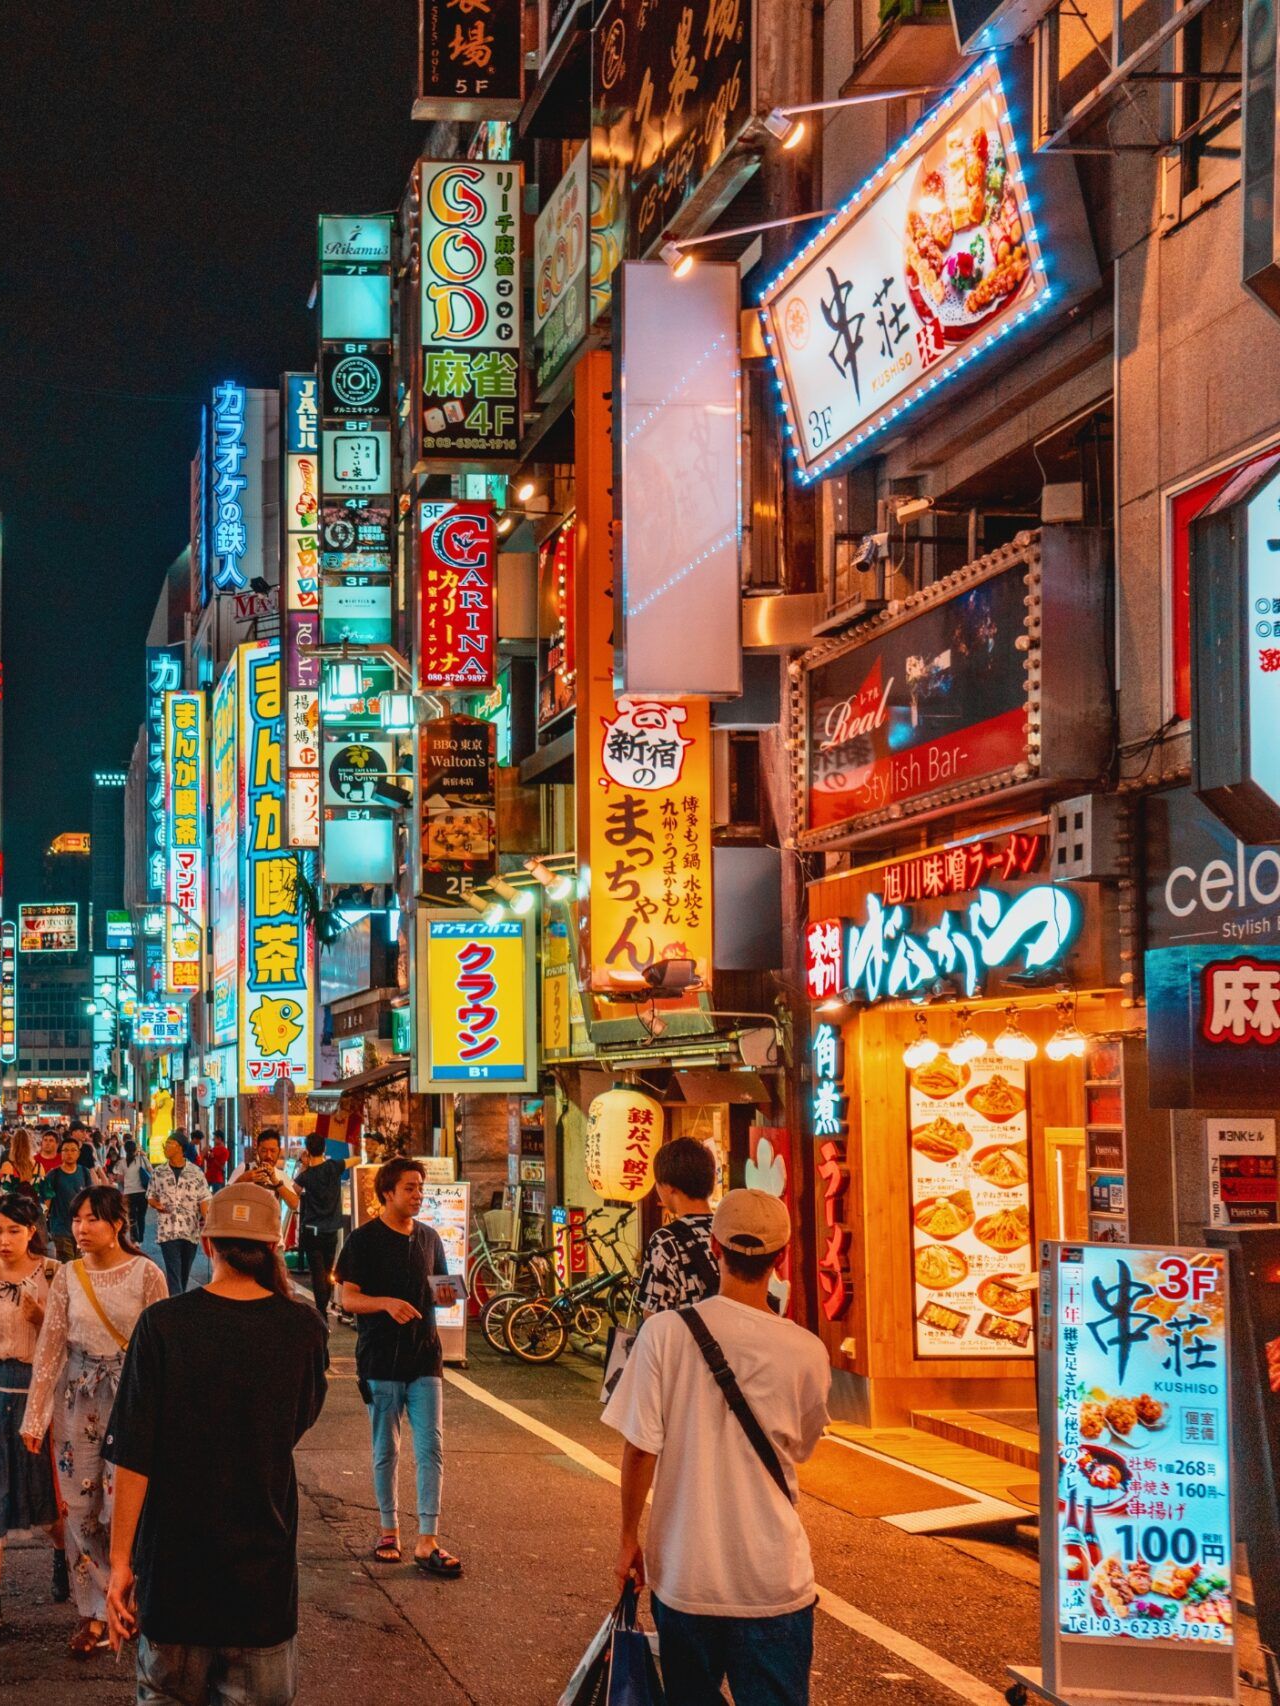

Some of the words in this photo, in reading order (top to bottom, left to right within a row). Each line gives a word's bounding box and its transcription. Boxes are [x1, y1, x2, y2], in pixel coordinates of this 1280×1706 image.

[455, 79, 488, 93] 5F
[427, 165, 488, 342] GOD
[345, 266, 368, 274] 7F
[345, 344, 368, 353] 6F
[423, 350, 518, 399] 麻雀
[871, 351, 913, 393] KUSHISO
[345, 421, 368, 430] 5F
[464, 401, 514, 437] 4F
[807, 405, 833, 448] 3F
[213, 381, 248, 590] カラオケの鉄人
[345, 500, 368, 508] 4F
[423, 505, 444, 517] 3F
[346, 577, 368, 585] 3F
[431, 514, 489, 674] CARINA
[438, 570, 459, 673] カリーナ
[428, 673, 487, 682] 080-8720-9897
[820, 676, 894, 750] Real
[347, 733, 369, 741] 1F
[433, 740, 458, 750] BBQ
[461, 739, 483, 750] 東京
[607, 729, 680, 770] 新宿
[431, 755, 486, 768] Walton's
[174, 702, 197, 845] まんが喫茶
[338, 773, 353, 782] The
[633, 768, 656, 787] の
[255, 661, 298, 984] まんが喫茶
[681, 795, 701, 870] 博多もつ鍋
[660, 797, 681, 925] 九州のうまかもん
[604, 794, 658, 974] まっちゃん
[683, 874, 703, 928] 水炊き
[1222, 917, 1270, 940] Stylish
[457, 942, 499, 1060] クラウン
[141, 1012, 168, 1024] 完全
[152, 1024, 179, 1036] 個室
[249, 1061, 304, 1078] マンボー
[469, 1067, 488, 1076] B1
[813, 1023, 840, 1135] 角煮
[619, 1107, 653, 1190] 鉄なべ餃子
[818, 1140, 844, 1321] ラーメン
[1158, 1258, 1217, 1301] 3F
[1086, 1259, 1217, 1386] 串荘
[1154, 1382, 1218, 1394] KUSHISO
[1186, 1411, 1214, 1425] 個室
[1186, 1427, 1214, 1440] 完備
[1129, 1482, 1170, 1494] 串焼き
[1129, 1503, 1186, 1521] 串揚げ
